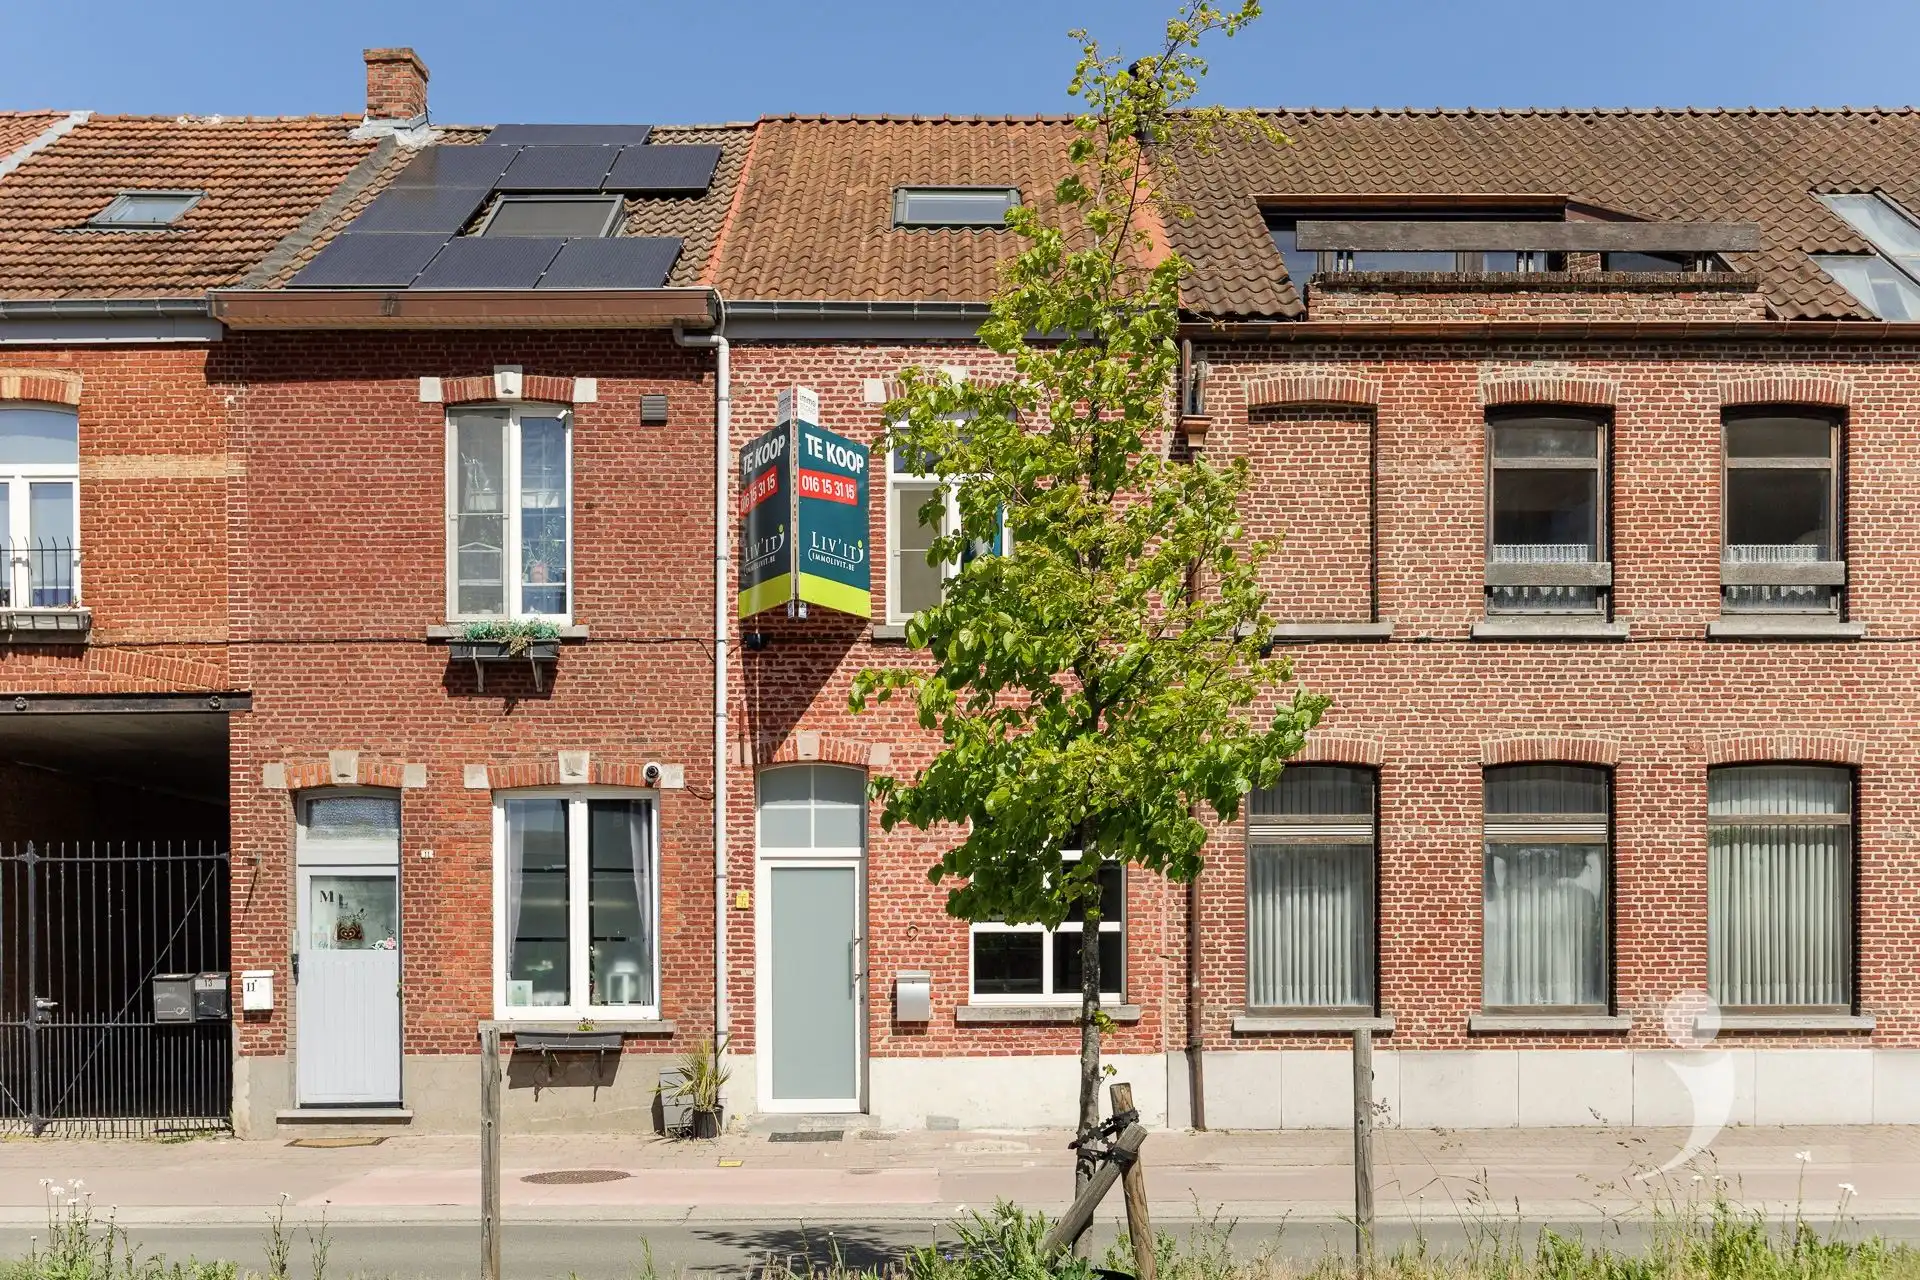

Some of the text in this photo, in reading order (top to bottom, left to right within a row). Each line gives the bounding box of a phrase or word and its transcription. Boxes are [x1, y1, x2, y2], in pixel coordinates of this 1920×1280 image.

[743, 434, 786, 475] TE KOOP
[805, 433, 864, 474] TE KOOP
[750, 486, 757, 502] 15
[758, 480, 766, 497] 31
[767, 473, 776, 491] 15
[802, 475, 855, 500] 016 15 31 15
[812, 552, 855, 572] IMMOLIVIT.BE
[320, 890, 334, 902] M
[906, 925, 918, 942] 9
[204, 979, 213, 988] 13
